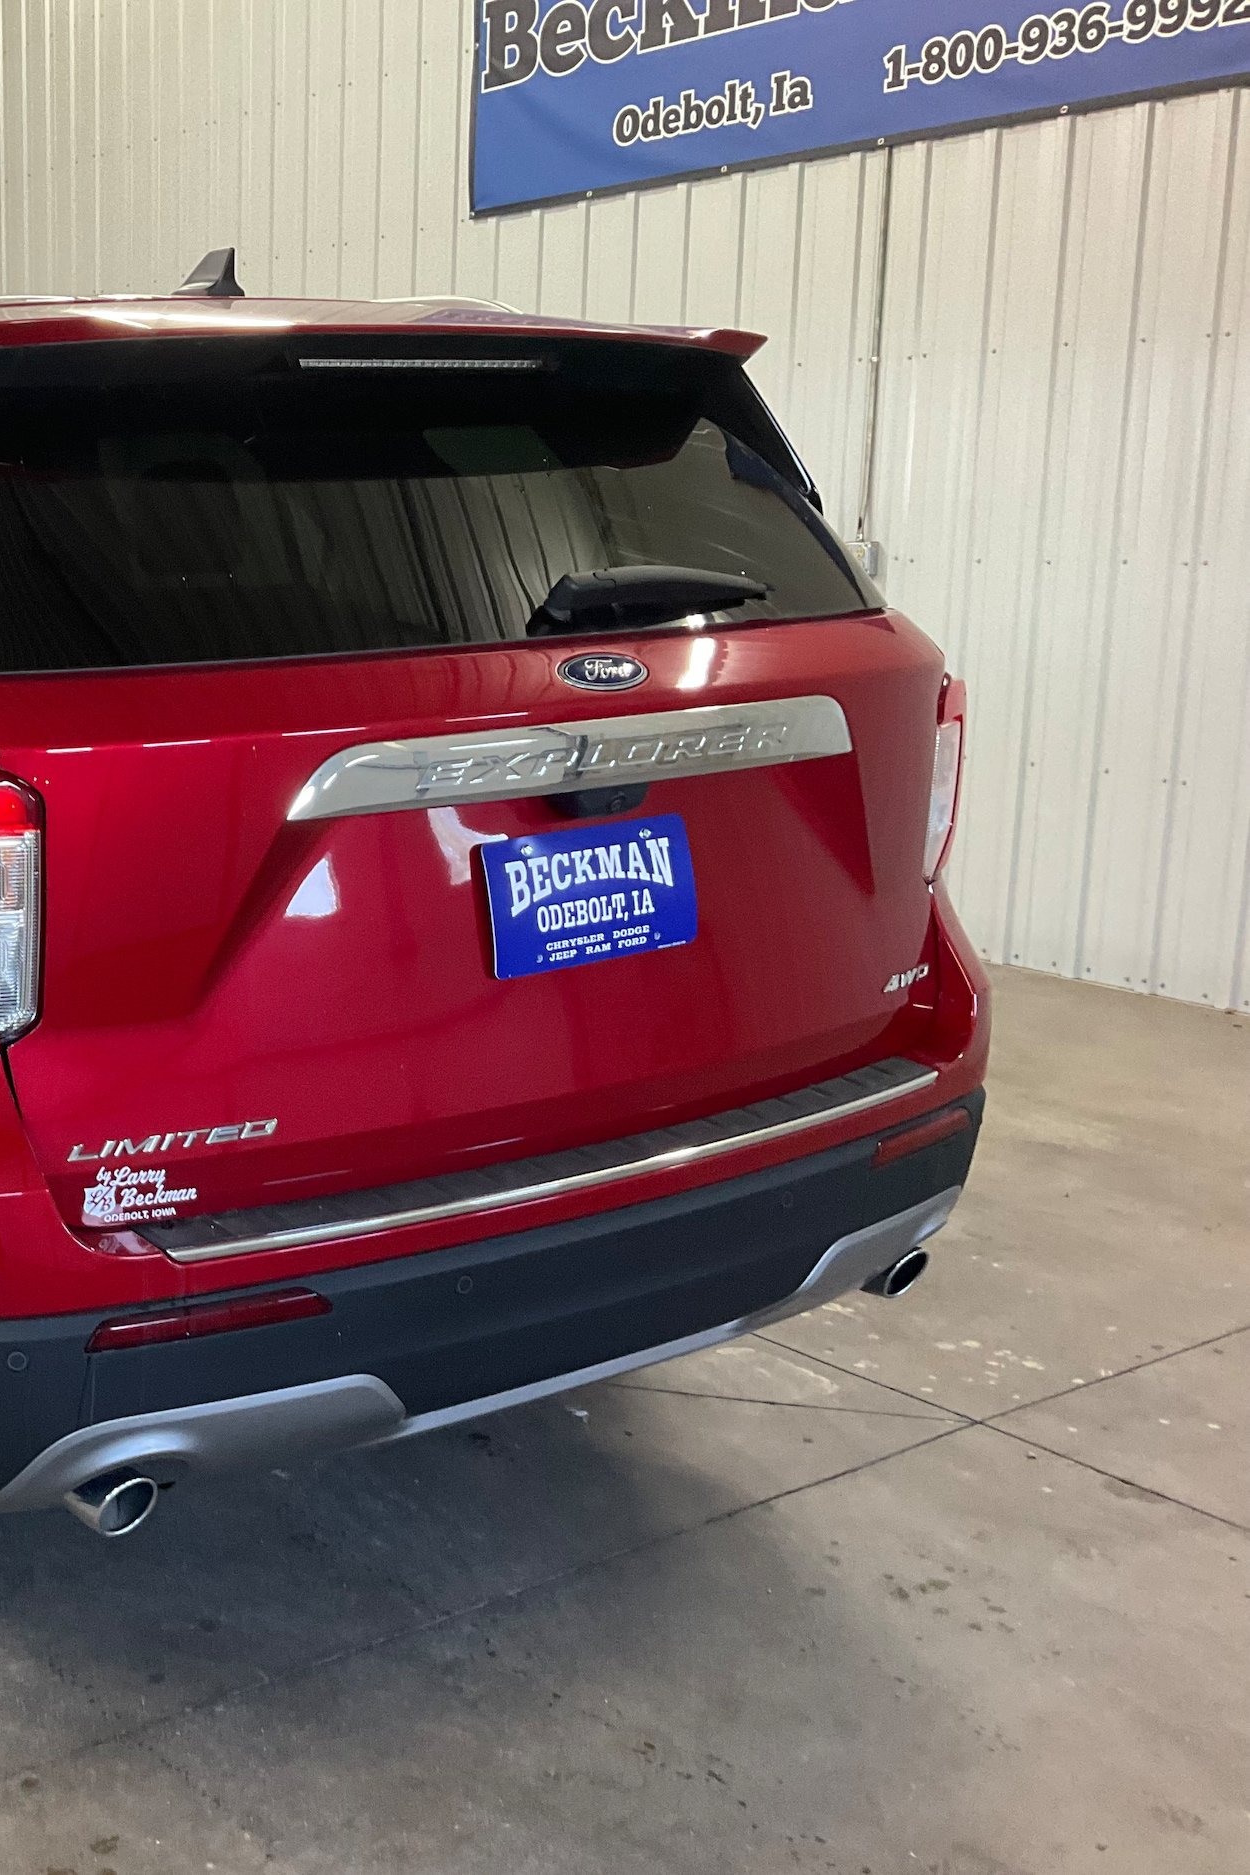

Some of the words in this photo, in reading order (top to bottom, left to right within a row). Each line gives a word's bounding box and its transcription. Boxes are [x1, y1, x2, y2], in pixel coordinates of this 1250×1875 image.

[613, 79, 764, 146] Odebolt,
[769, 71, 813, 116] Ia
[584, 659, 634, 681] Ford
[418, 722, 789, 793] EXPLORER
[504, 836, 674, 918] BECKMAN
[536, 893, 629, 933] ODEBOLT,
[631, 888, 655, 916] IA
[545, 932, 605, 951] CHRYSLER
[612, 924, 651, 939] DODGE
[548, 949, 578, 962] JEEP
[585, 942, 612, 955] RAM
[617, 936, 648, 949] FORD
[66, 1117, 278, 1162] LIMITED
[96, 1166, 111, 1186] by
[110, 1165, 166, 1189] Larry
[120, 1184, 198, 1208] Beckman
[151, 1207, 177, 1218] IOWA
